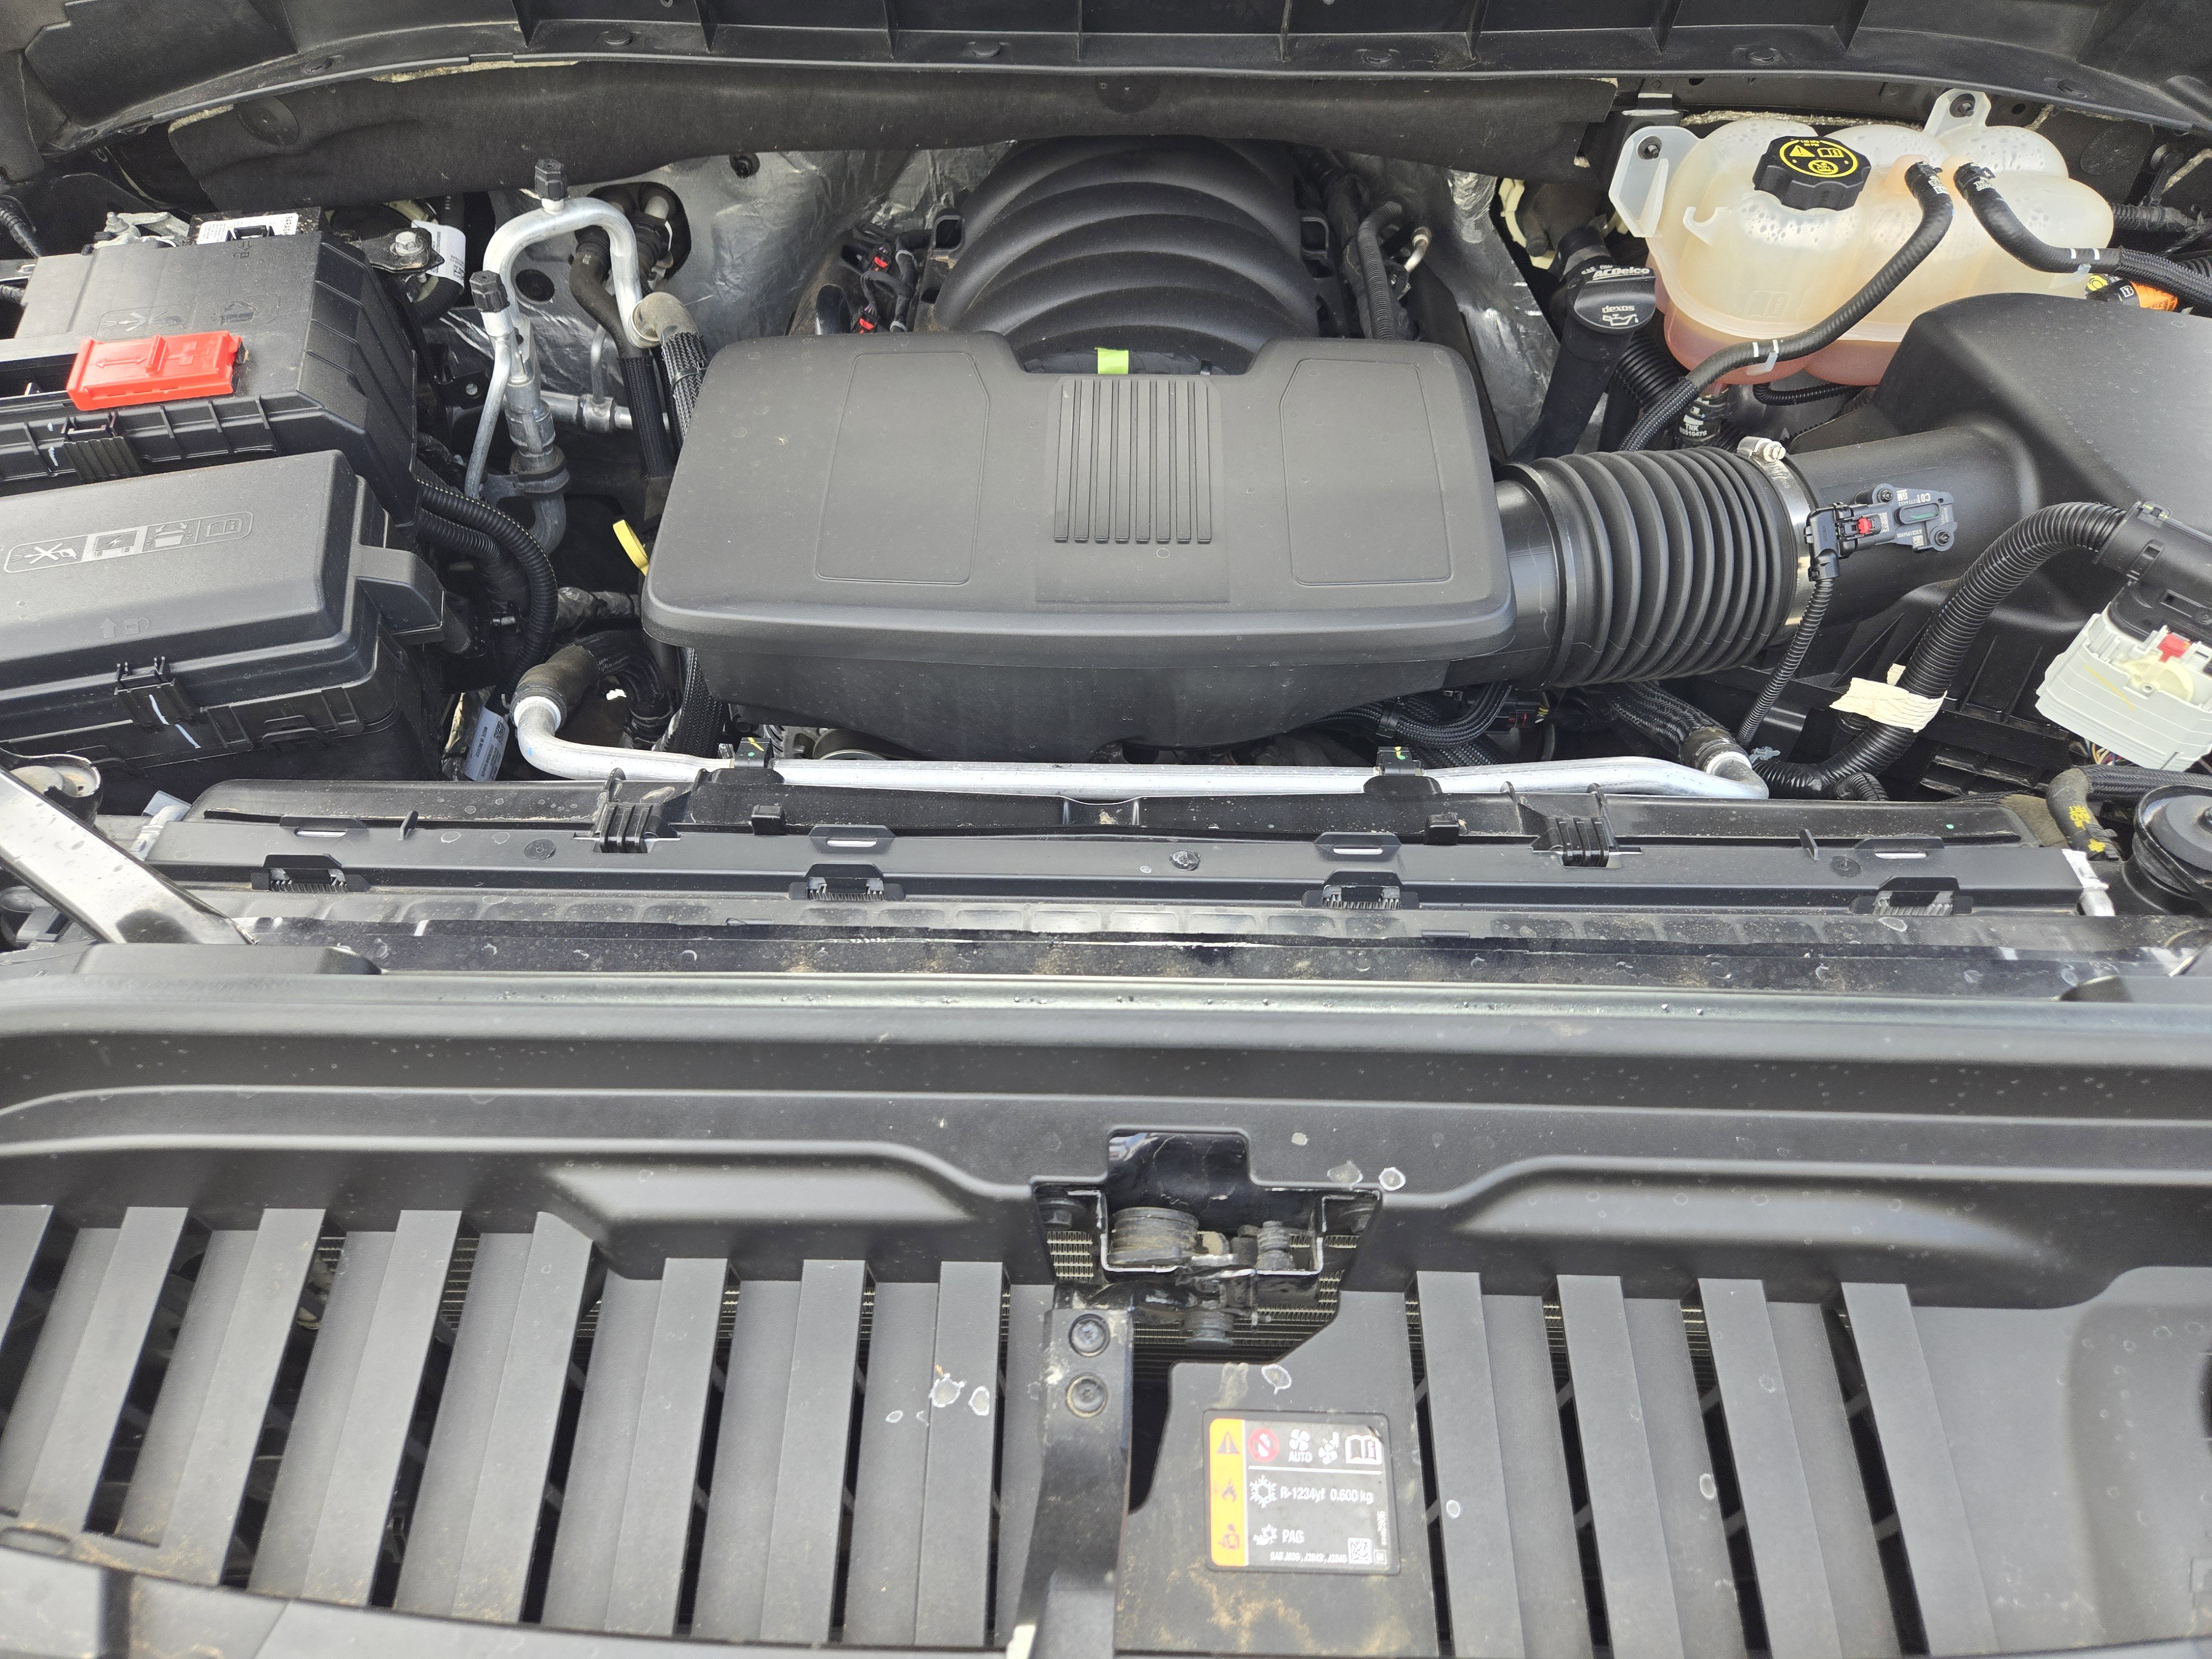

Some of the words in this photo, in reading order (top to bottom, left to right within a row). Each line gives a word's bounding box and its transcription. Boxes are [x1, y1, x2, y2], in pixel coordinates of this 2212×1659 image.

[1592, 267, 1650, 279] ACDelco
[1602, 305, 1635, 314] dexos
[1685, 423, 1699, 431] TNK
[1897, 490, 1908, 501] GM
[1288, 1451, 1313, 1463] AUTO
[1280, 1486, 1326, 1503] R-1234yf
[1360, 1490, 1374, 1505] kg
[1282, 1529, 1305, 1544] PAG
